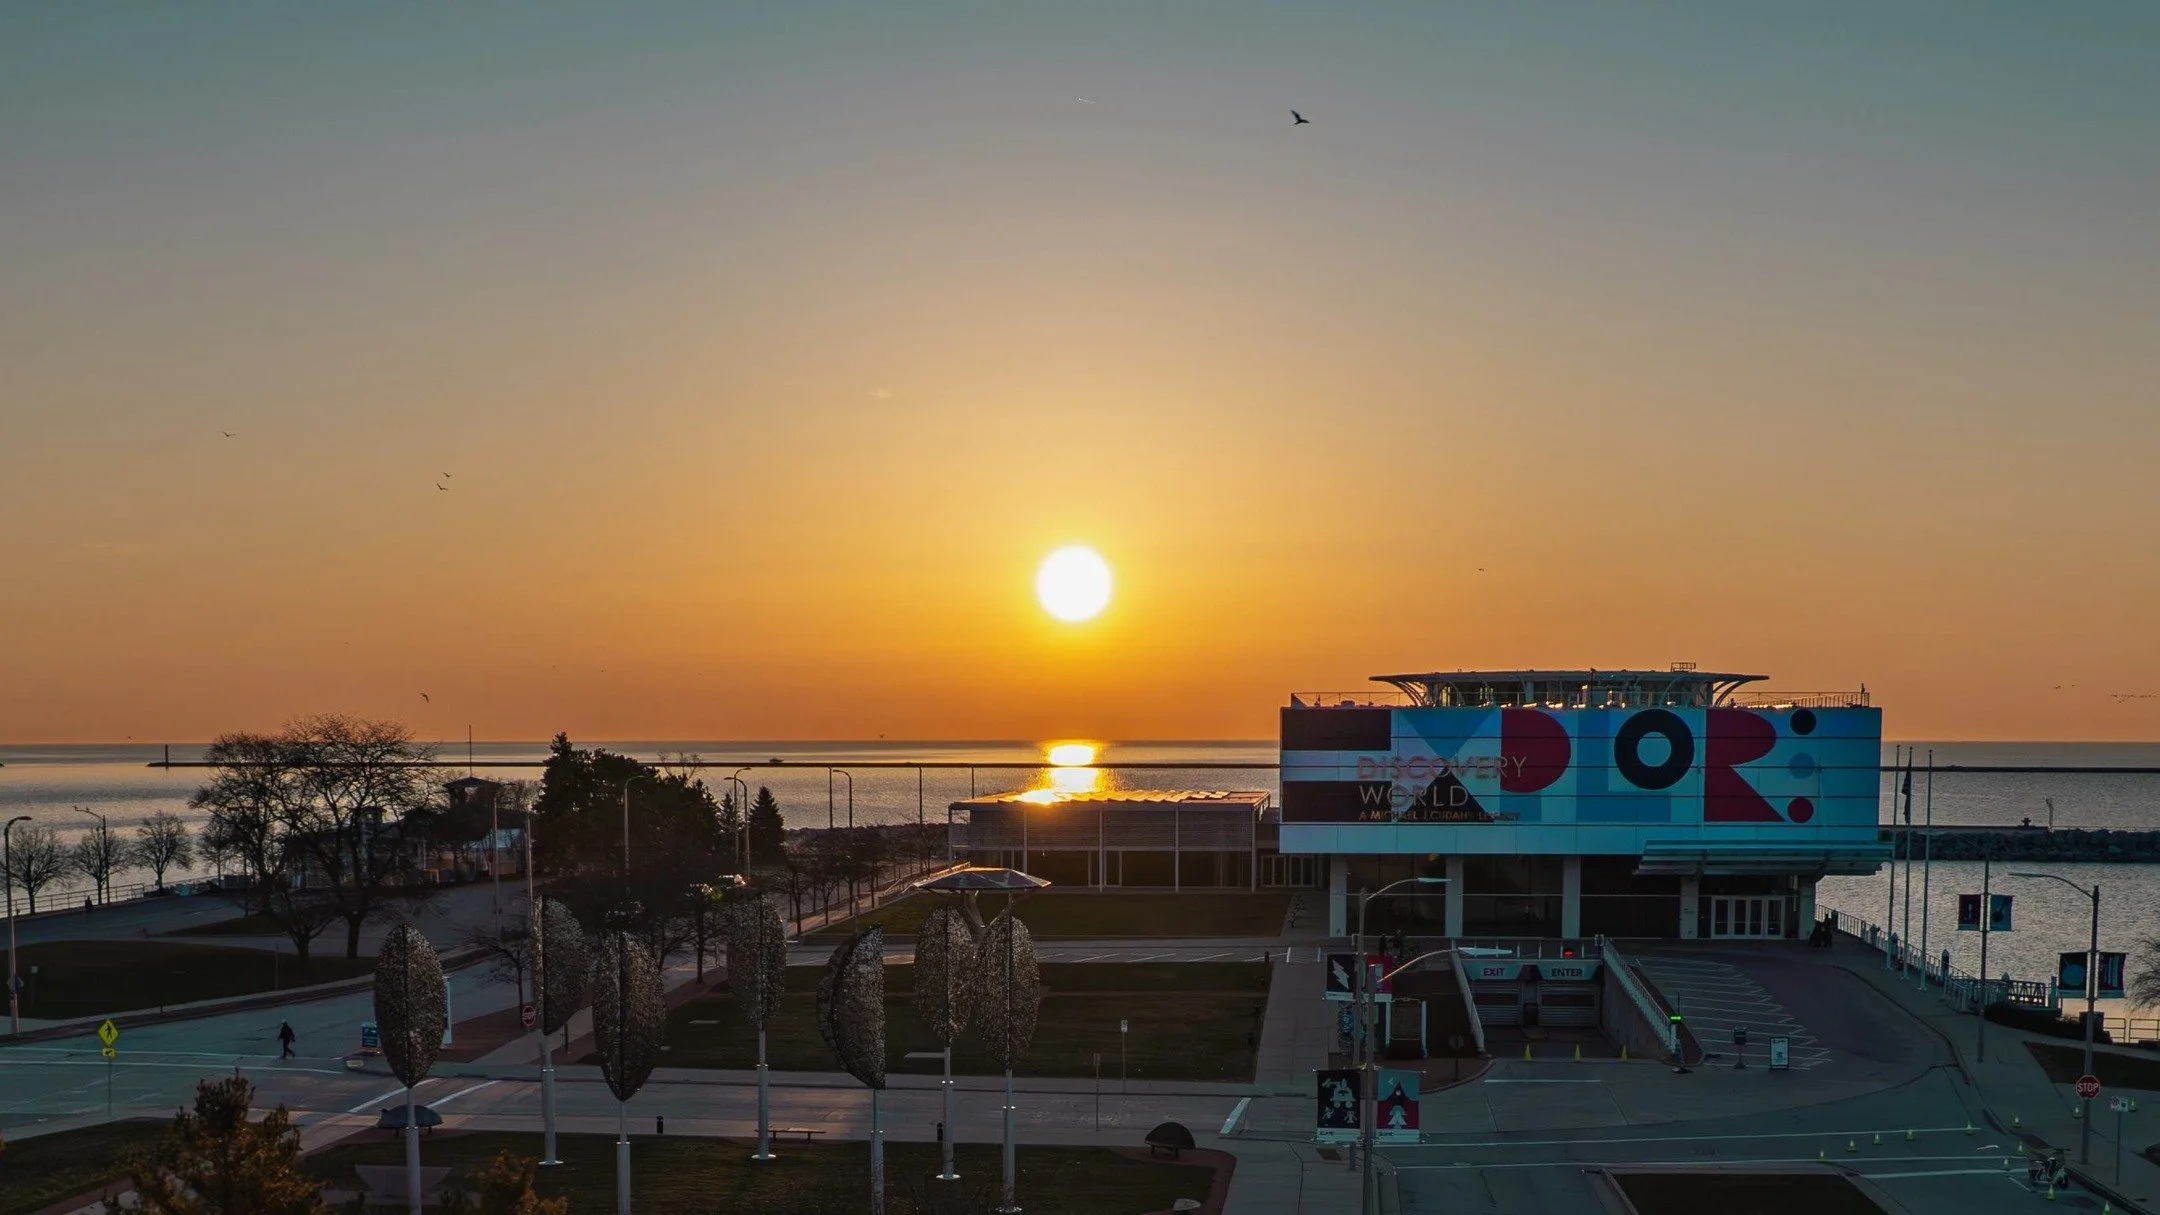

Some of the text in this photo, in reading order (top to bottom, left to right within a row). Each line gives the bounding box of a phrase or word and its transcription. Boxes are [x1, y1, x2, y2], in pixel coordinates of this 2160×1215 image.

[1357, 755, 1527, 779] DISCOVERY
[1358, 785, 1469, 807] WORLD
[1483, 968, 1505, 976] EXIT
[1552, 967, 1583, 976] ENTER
[2077, 1083, 2099, 1092] STOP
